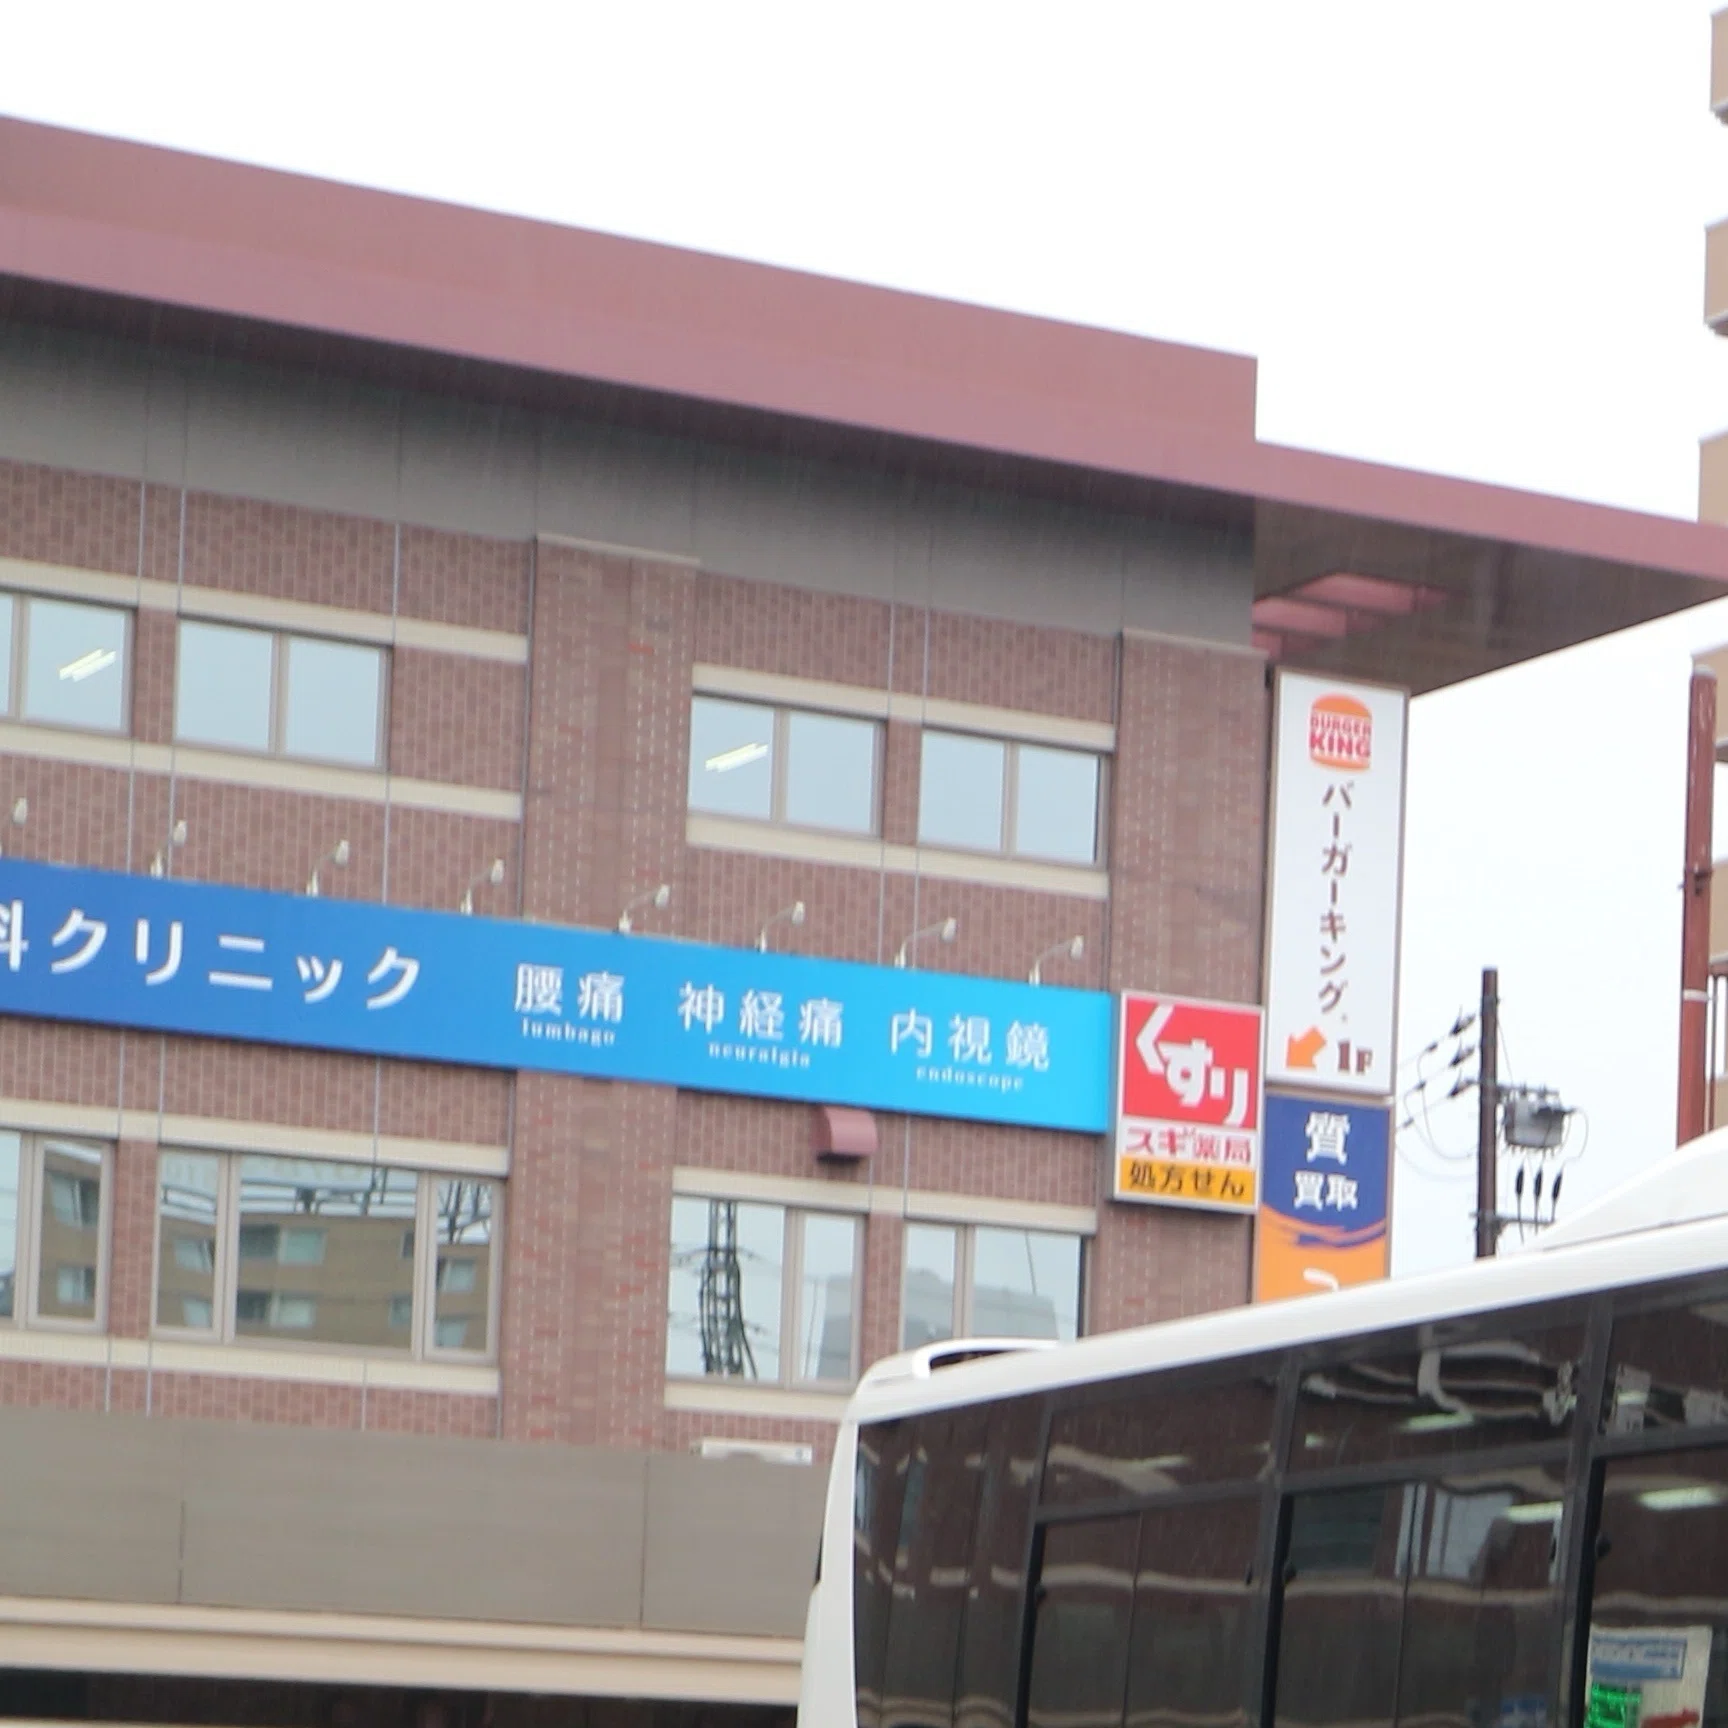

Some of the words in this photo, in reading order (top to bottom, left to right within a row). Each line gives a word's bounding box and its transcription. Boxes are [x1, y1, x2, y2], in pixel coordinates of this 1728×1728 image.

[1310, 713, 1371, 738] BURGER
[1309, 733, 1371, 759] KING
[1318, 782, 1354, 1014] バーガーキング
[514, 962, 625, 1024] 腰痛
[677, 980, 844, 1049] 神経痛
[890, 1006, 1051, 1072] 内視鏡
[520, 1017, 617, 1048] lumbago
[707, 1041, 811, 1069] neuralgia
[1134, 1003, 1250, 1127] くすり
[1336, 1038, 1373, 1076] 1F
[915, 1064, 1024, 1093] endoscope
[1125, 1126, 1252, 1164] スギ薬局
[1305, 1111, 1351, 1166] 質
[1128, 1160, 1245, 1199] 処方せん
[1293, 1170, 1359, 1212] 買取
